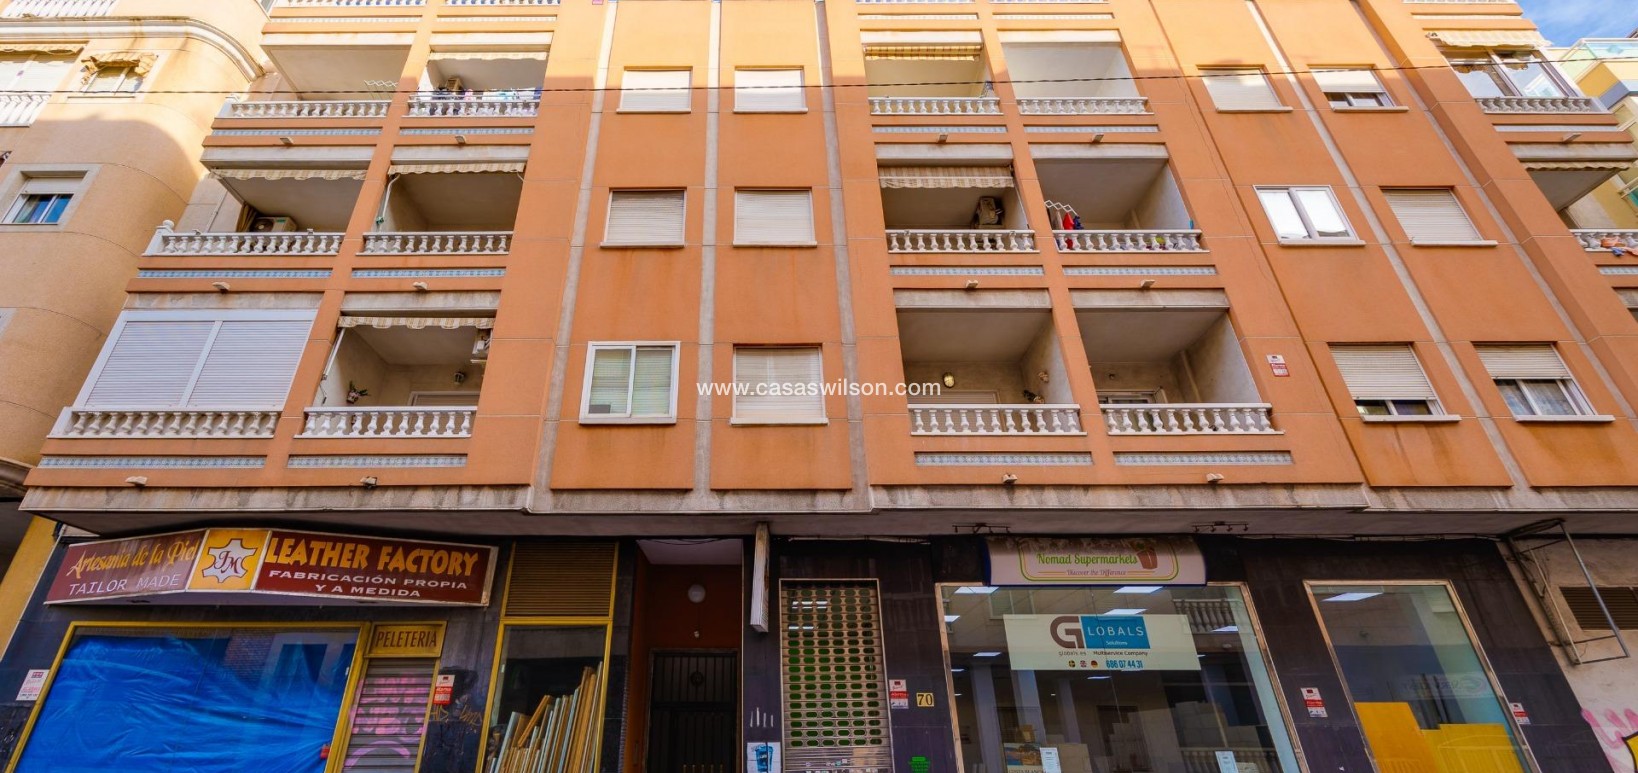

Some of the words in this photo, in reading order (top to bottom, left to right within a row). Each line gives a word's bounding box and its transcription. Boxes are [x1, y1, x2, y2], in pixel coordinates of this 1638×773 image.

[132, 549, 146, 568] de
[150, 548, 163, 567] la
[167, 540, 197, 571] Piel
[265, 538, 369, 569] LEATHER
[377, 546, 479, 577] FACTORY
[1037, 553, 1072, 565] Nomad
[1074, 553, 1138, 567] Supermarkets
[69, 579, 127, 596] TAILOR
[136, 573, 182, 590] MADE
[269, 570, 396, 585] FABRICACIÓN
[403, 578, 467, 590] PROPIA
[315, 584, 327, 593] Y
[331, 585, 343, 594] A
[350, 586, 421, 598] MEDIDA
[376, 631, 437, 648] PELETERIA
[917, 693, 934, 706] 70
